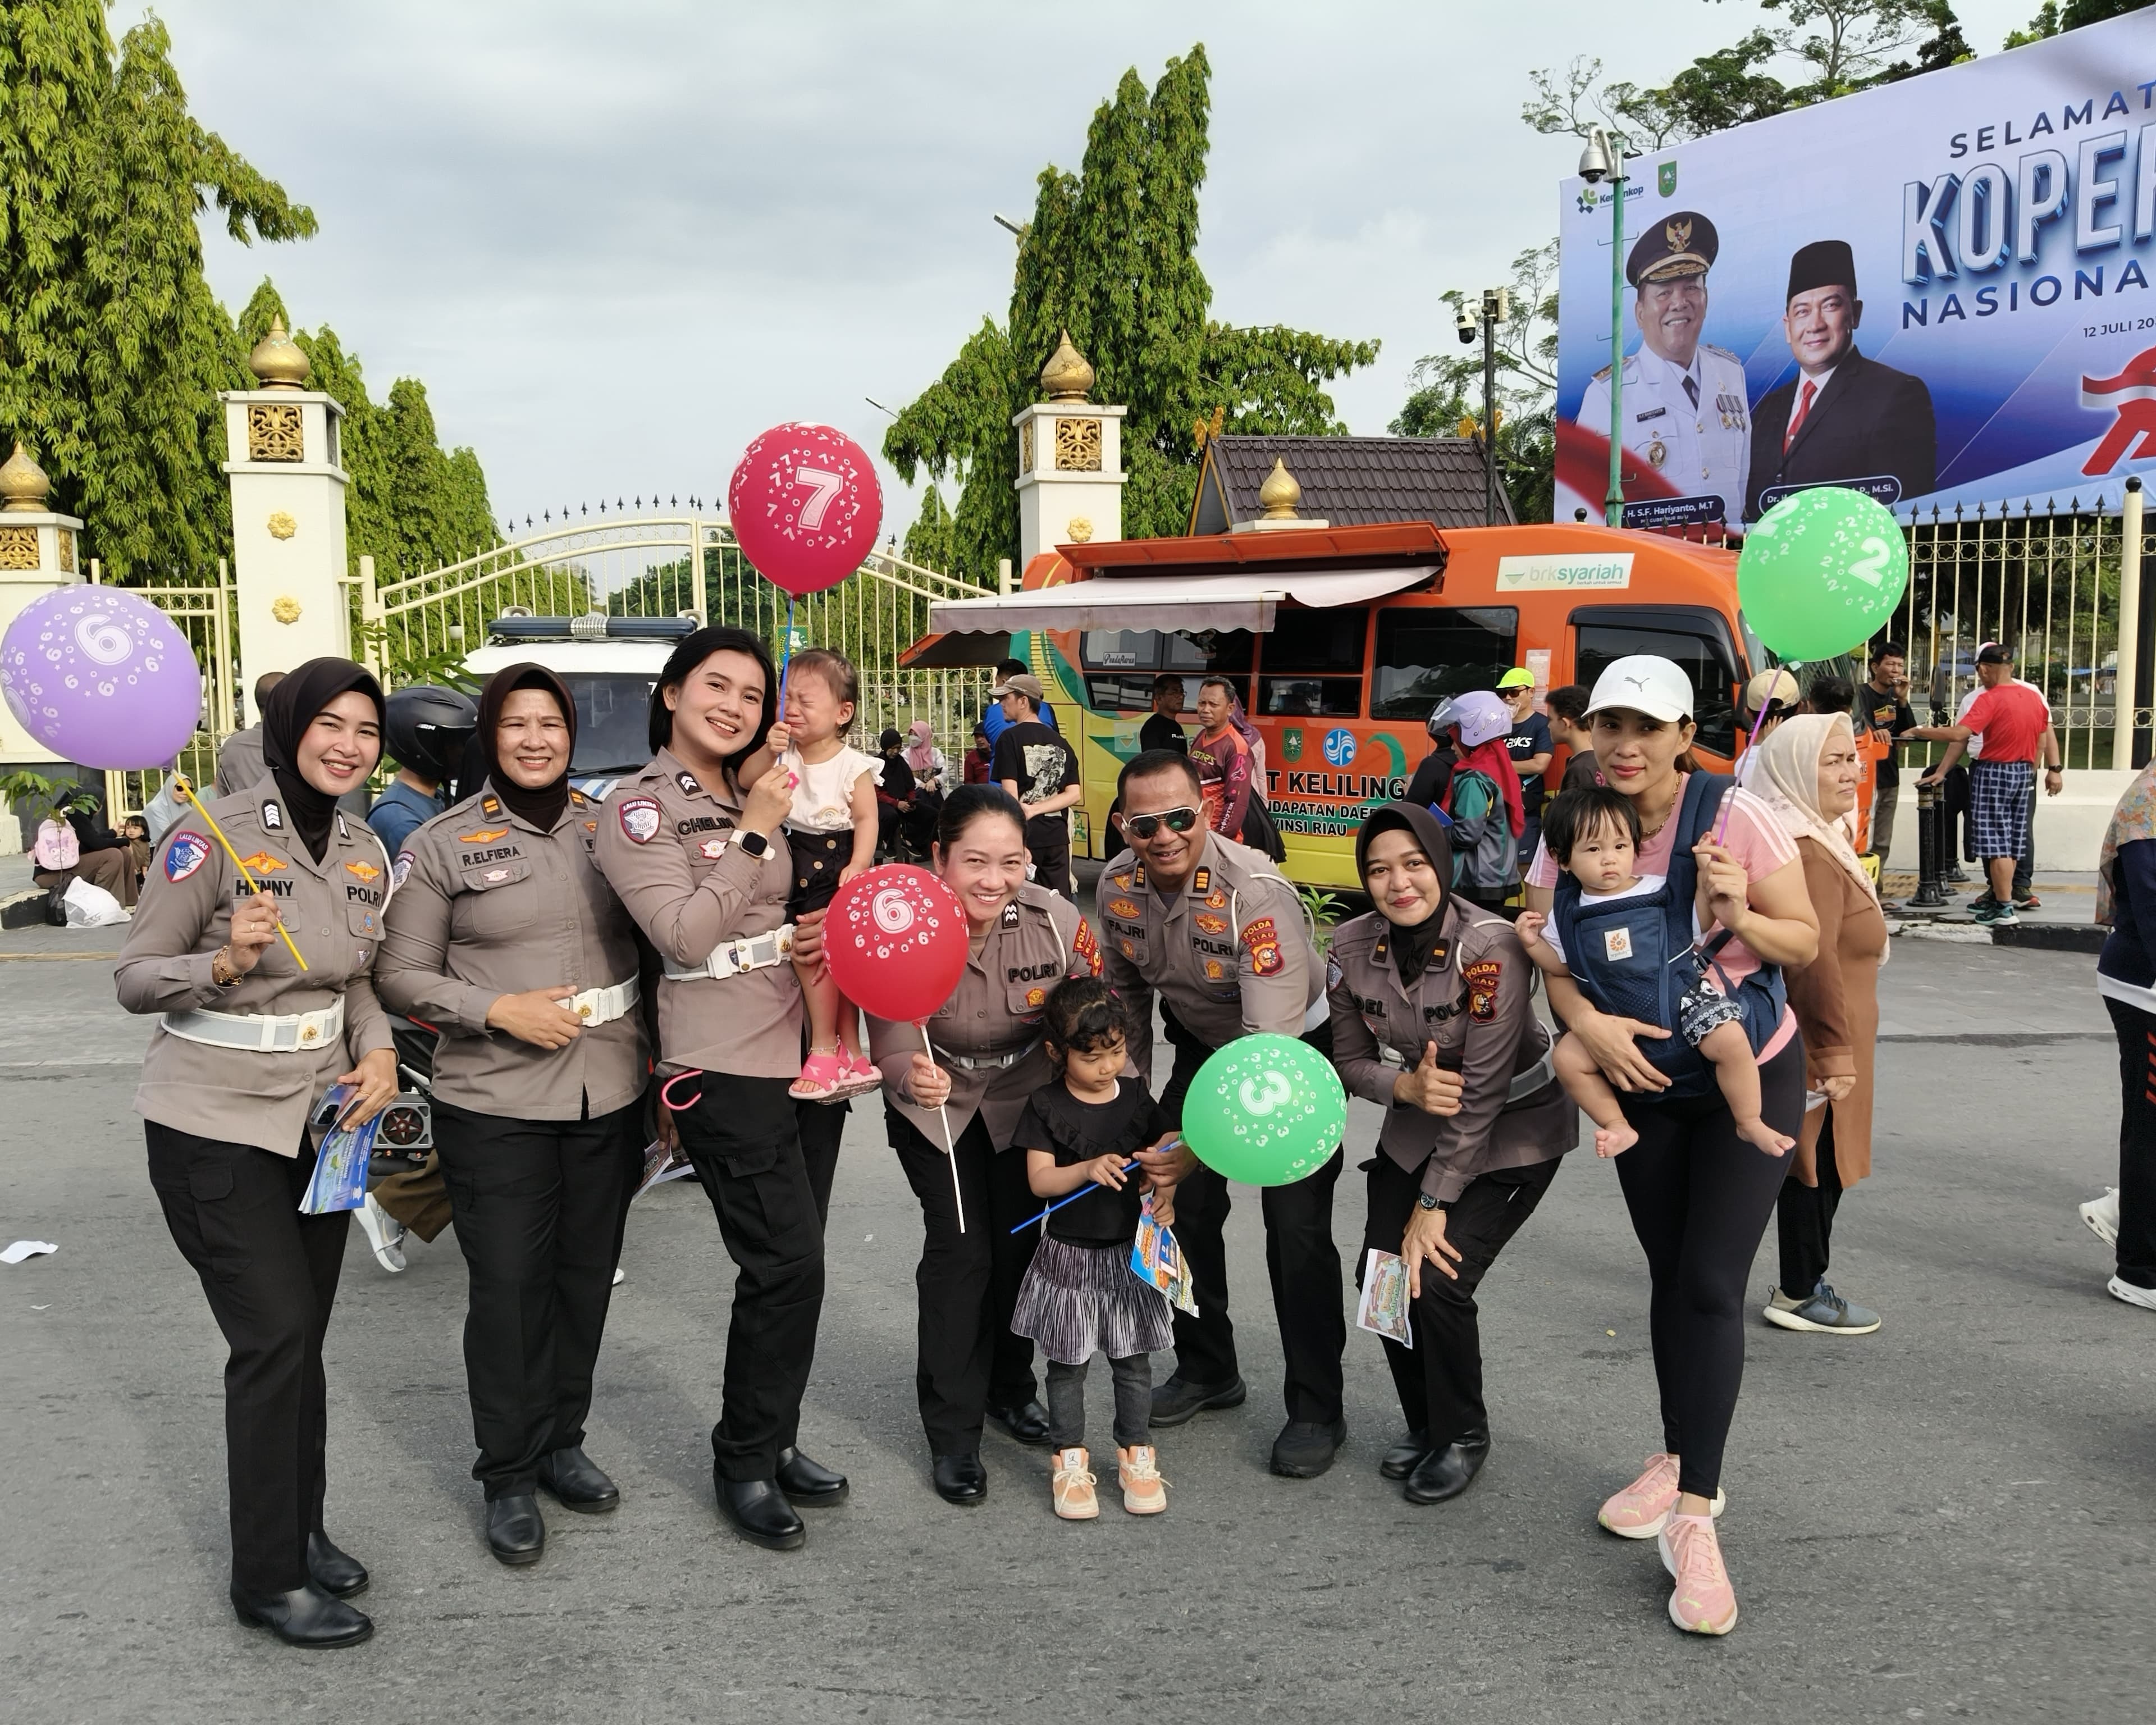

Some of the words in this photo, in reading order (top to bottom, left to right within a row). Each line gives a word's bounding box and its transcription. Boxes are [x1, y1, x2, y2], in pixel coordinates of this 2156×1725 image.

[1950, 80, 2156, 158] SELAMAT
[2084, 327, 2096, 338] 12
[2100, 321, 2131, 335] JULI
[2137, 317, 2156, 330] 20
[795, 466, 843, 530] 7
[1872, 483, 1894, 494] M.Si.
[1650, 514, 1676, 523] GUBENUR
[1654, 504, 1696, 516] Hariyanto,
[1699, 501, 1714, 510] M.T
[1848, 537, 1890, 587] 2
[1529, 564, 1624, 585] brksyariah
[75, 614, 133, 665] 6
[1288, 771, 1403, 801] KELILING
[623, 800, 637, 811] LALU
[1313, 822, 1347, 837] RIAU
[192, 836, 209, 850] LINTAS
[462, 846, 520, 867] R.ELFIERA
[346, 886, 381, 908] POLRI
[873, 888, 914, 933] 6
[1108, 920, 1145, 940] FAJRI
[1244, 920, 1272, 939] POLDA
[1251, 932, 1275, 943] RIAU
[1193, 937, 1234, 956] POLRI
[1008, 962, 1058, 983] POLRI
[1466, 964, 1498, 979] POLDA
[1239, 1070, 1292, 1116] 3
